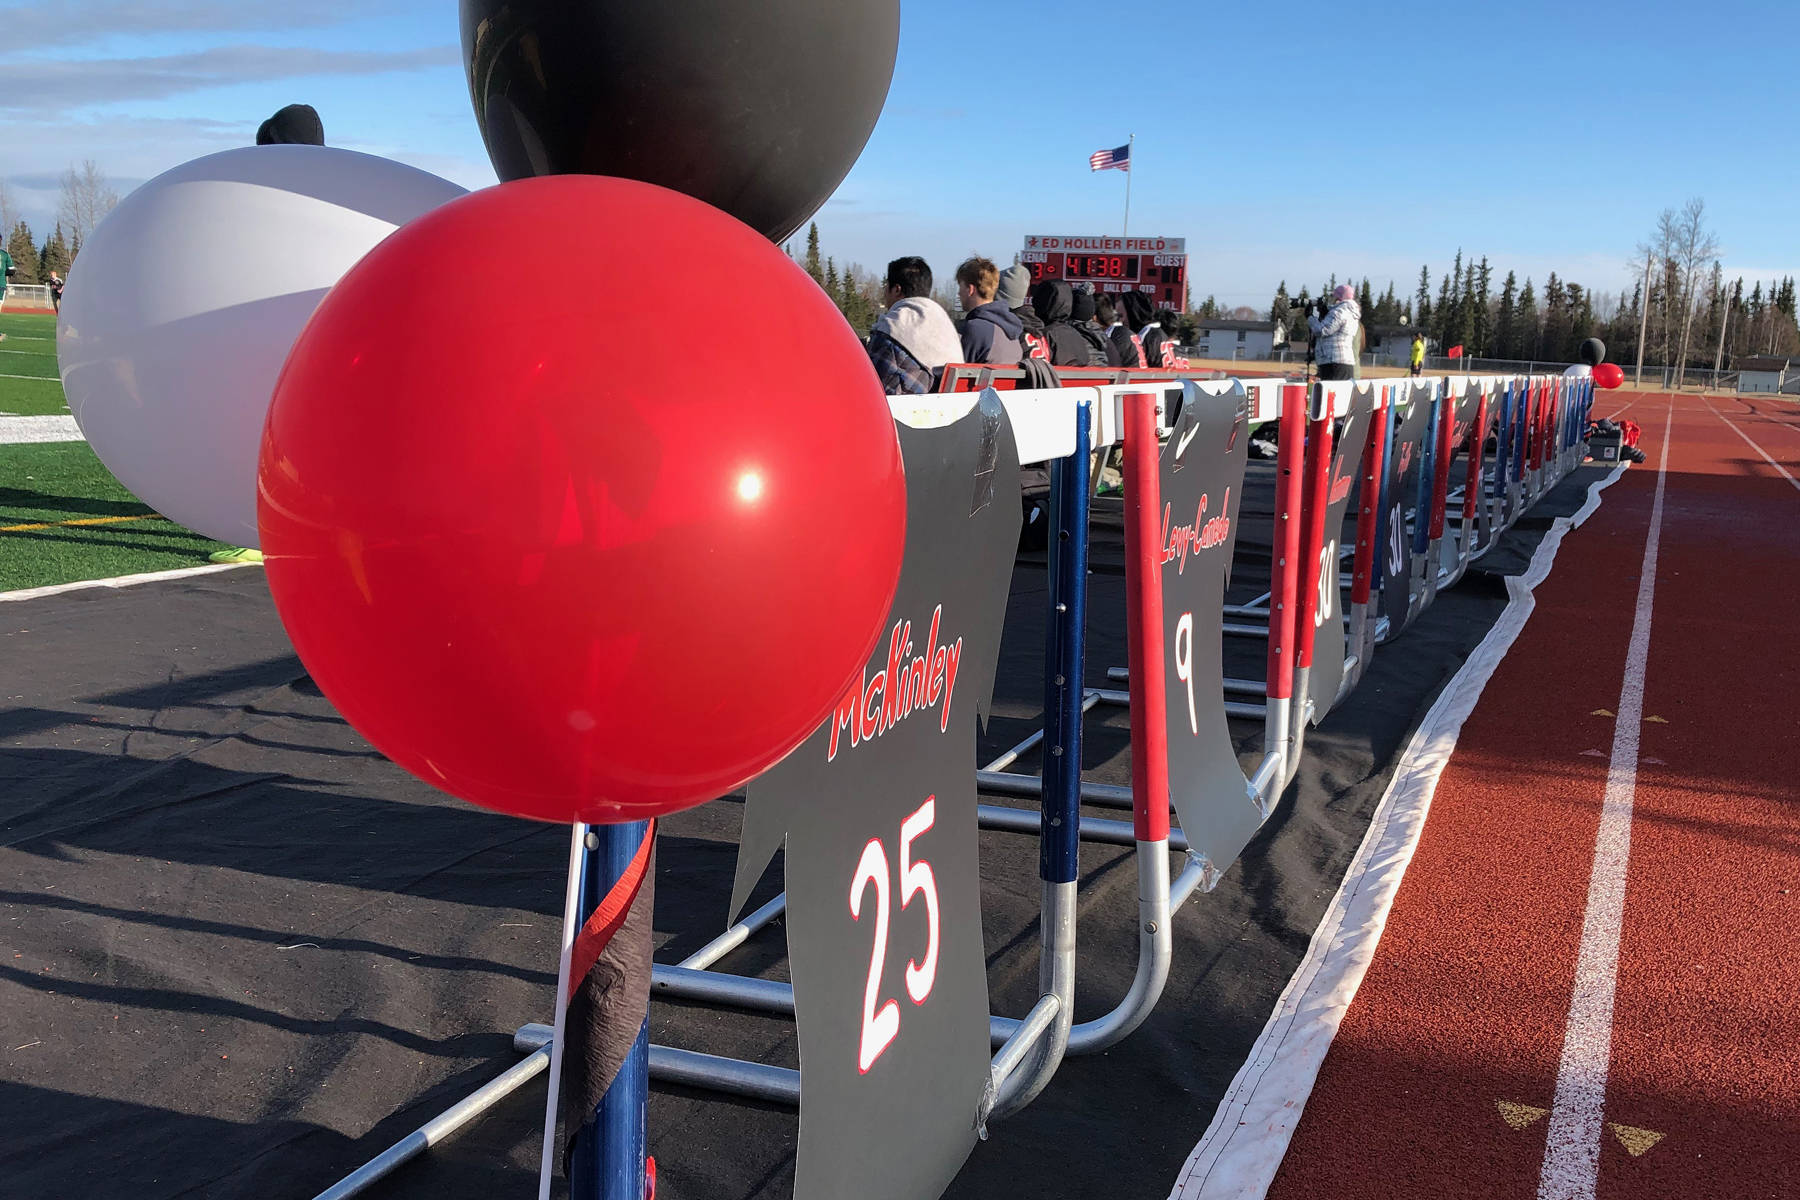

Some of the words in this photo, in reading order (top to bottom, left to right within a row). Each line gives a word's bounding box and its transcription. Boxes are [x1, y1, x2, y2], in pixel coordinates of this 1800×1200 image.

[1042, 238, 1059, 248] ED
[1064, 238, 1121, 249] HOLLIER
[1126, 239, 1165, 250] FIELD
[1067, 257, 1121, 277] 41:38
[1154, 255, 1184, 267] GUEST
[1034, 263, 1042, 279] 3
[1103, 283, 1120, 293] BALL
[1139, 284, 1156, 294] QTR
[1174, 611, 1199, 736] 9
[826, 603, 963, 764] McKinley
[849, 793, 941, 1076] 25
